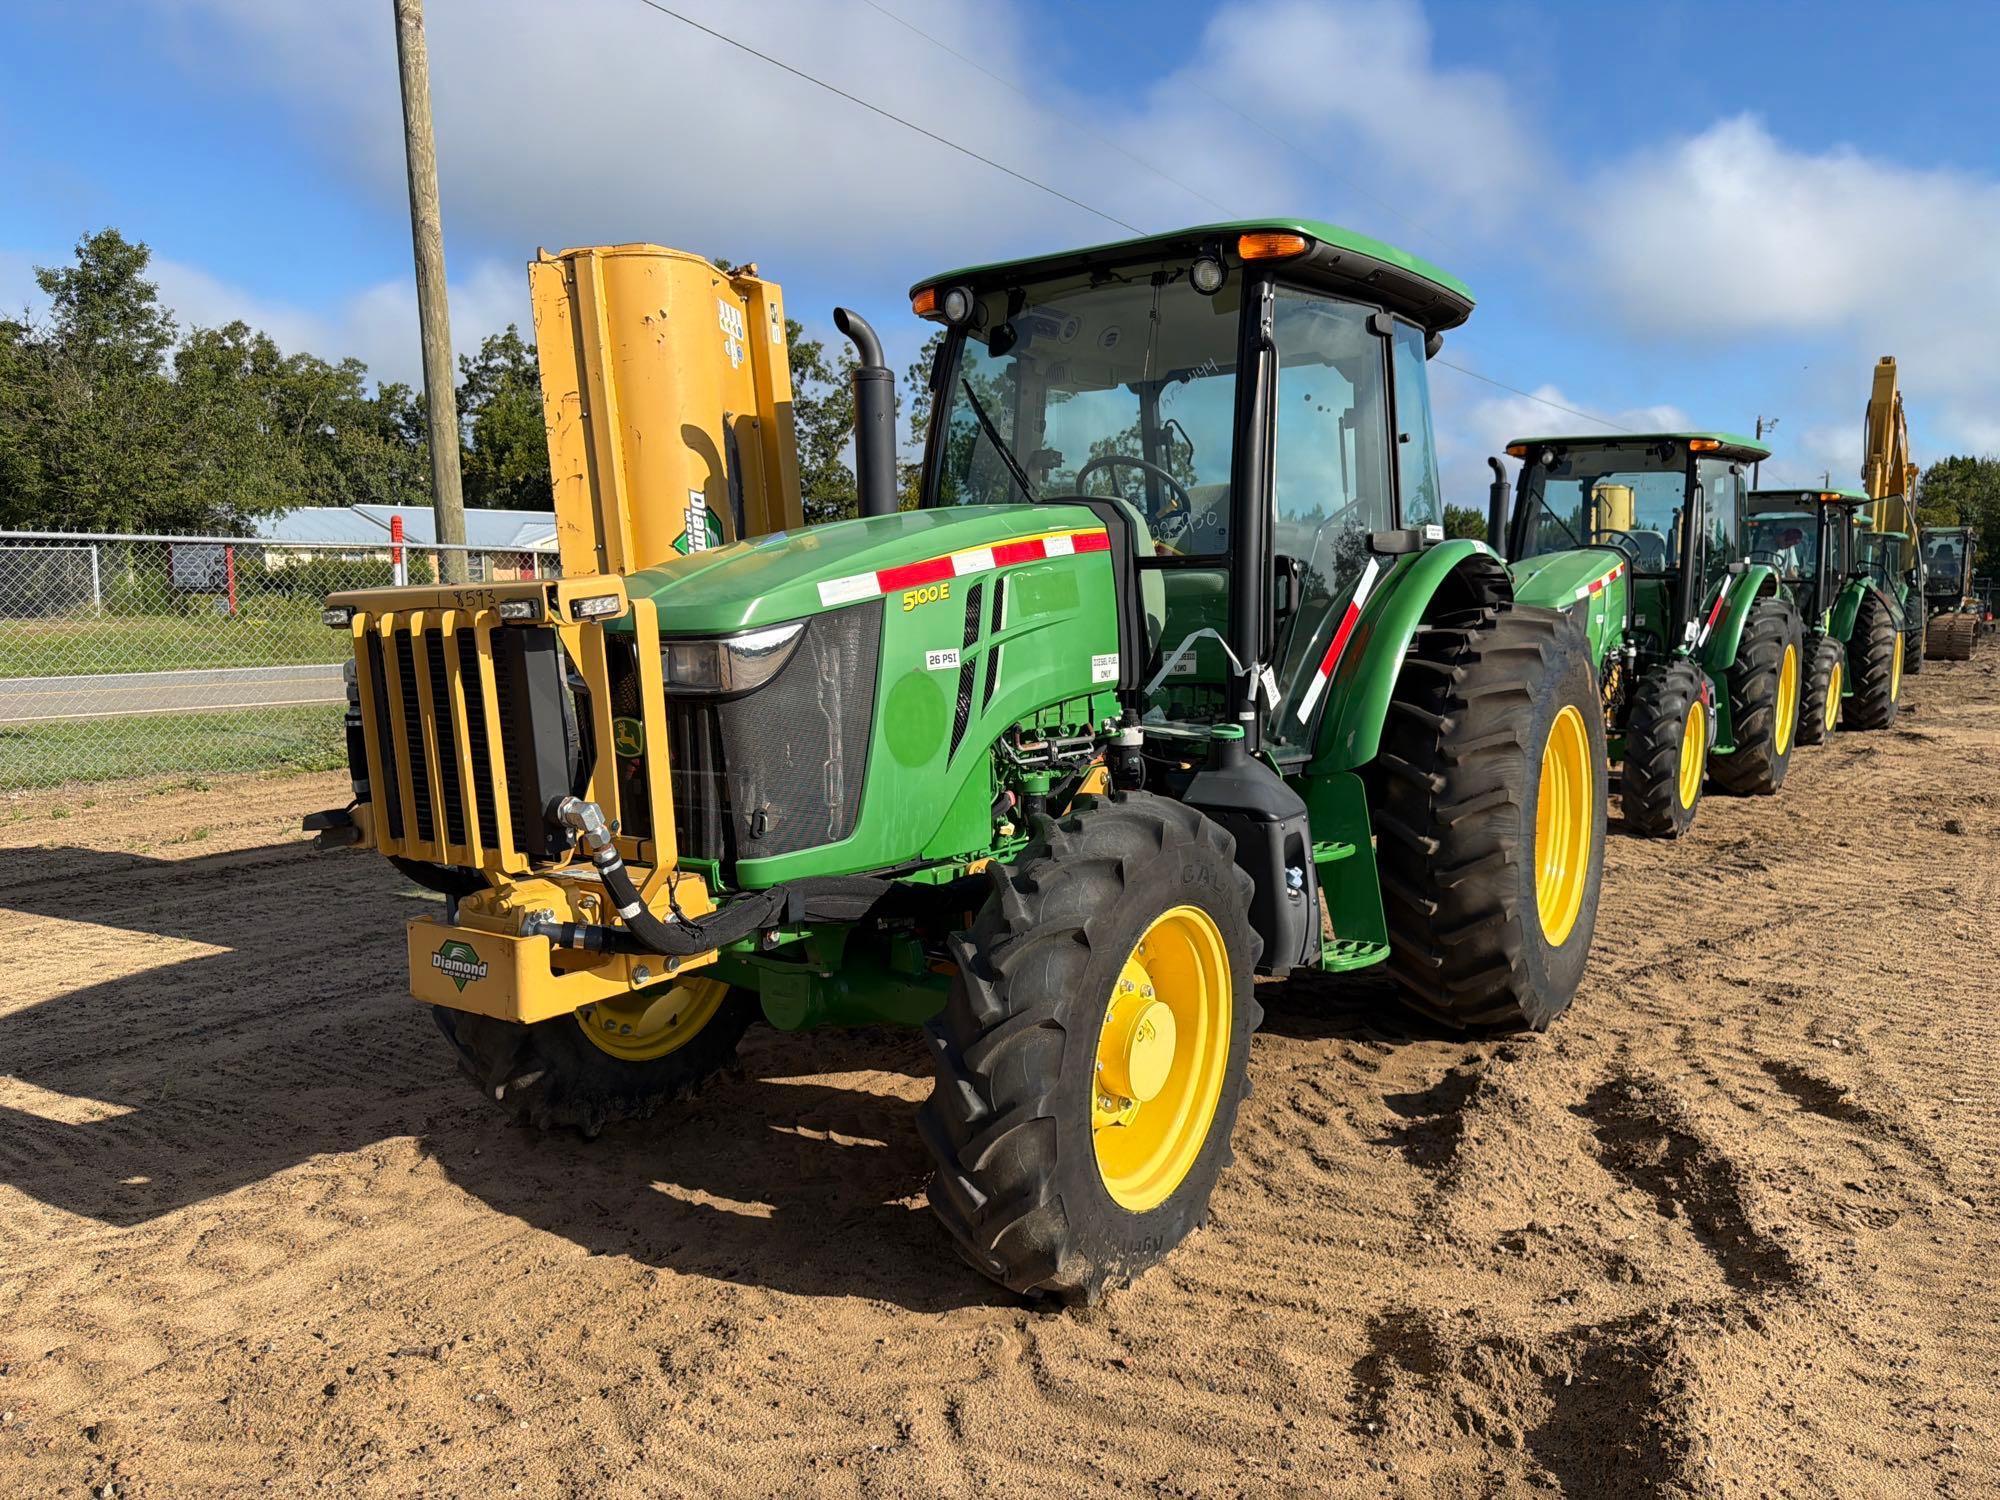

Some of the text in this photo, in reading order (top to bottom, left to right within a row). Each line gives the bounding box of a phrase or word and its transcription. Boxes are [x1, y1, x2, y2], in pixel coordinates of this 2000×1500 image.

[690, 490, 707, 551] Diam
[929, 653, 957, 665] 26 PSI
[1100, 669, 1112, 678] ONLY
[432, 953, 487, 977] Diamond
